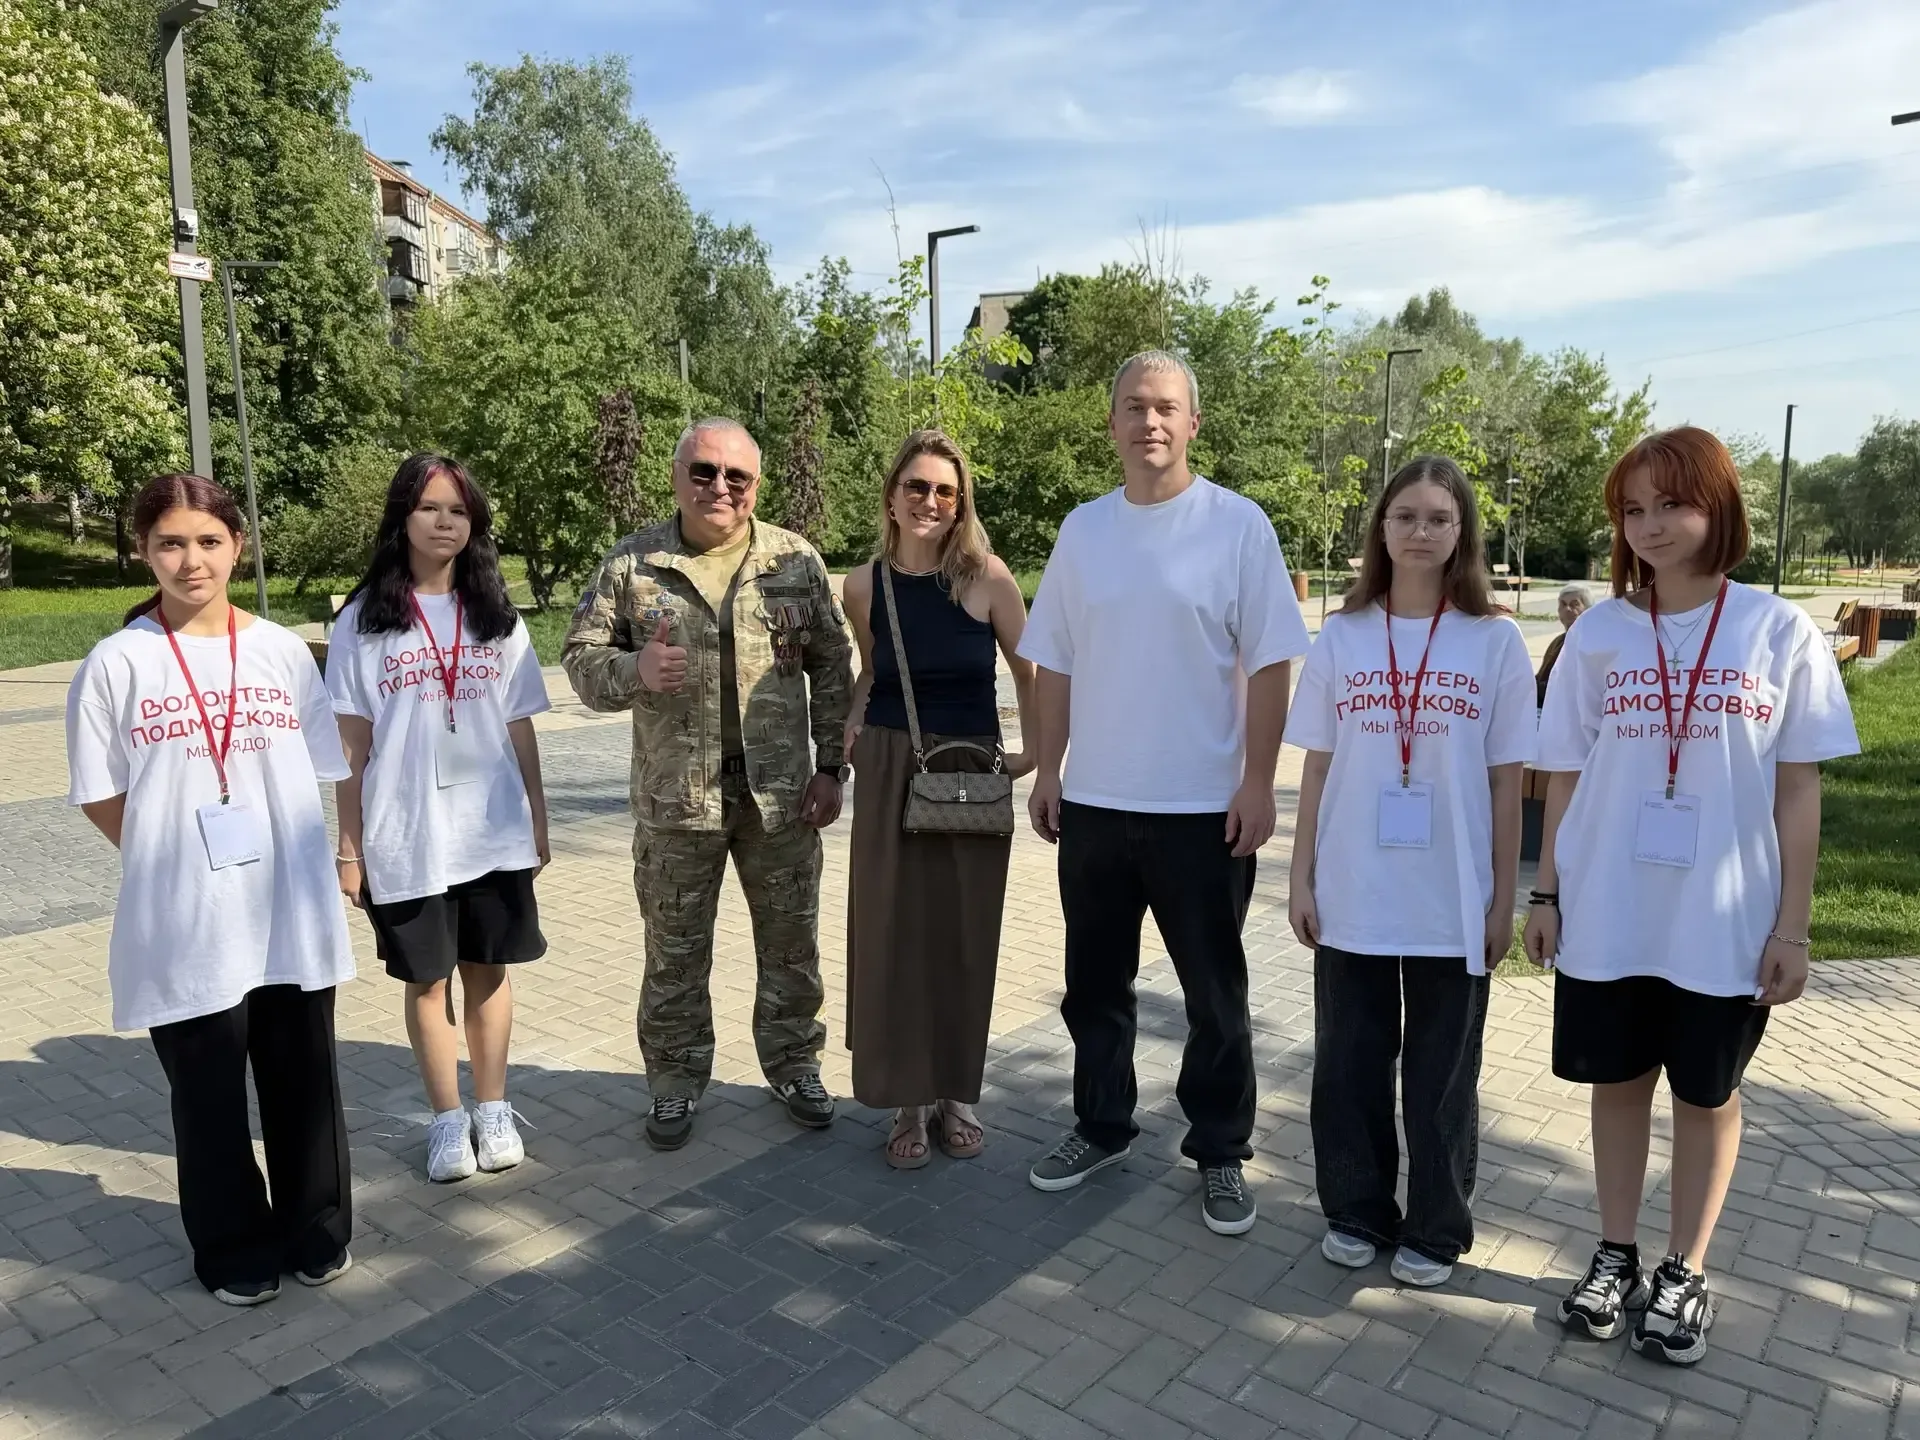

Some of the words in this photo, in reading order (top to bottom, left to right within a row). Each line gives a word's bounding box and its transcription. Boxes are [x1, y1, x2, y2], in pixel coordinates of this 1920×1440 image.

[1604, 668, 1760, 693] ОЛОНТЕРЫ
[438, 688, 487, 701] РДОМ
[1603, 693, 1773, 724] ДМОСКОВЬЯ
[130, 709, 300, 749] ПОДМОСКОВЬ
[1361, 720, 1389, 734] МЫ
[1617, 724, 1643, 739] МЫ
[1650, 723, 1719, 741] РЯДОМ
